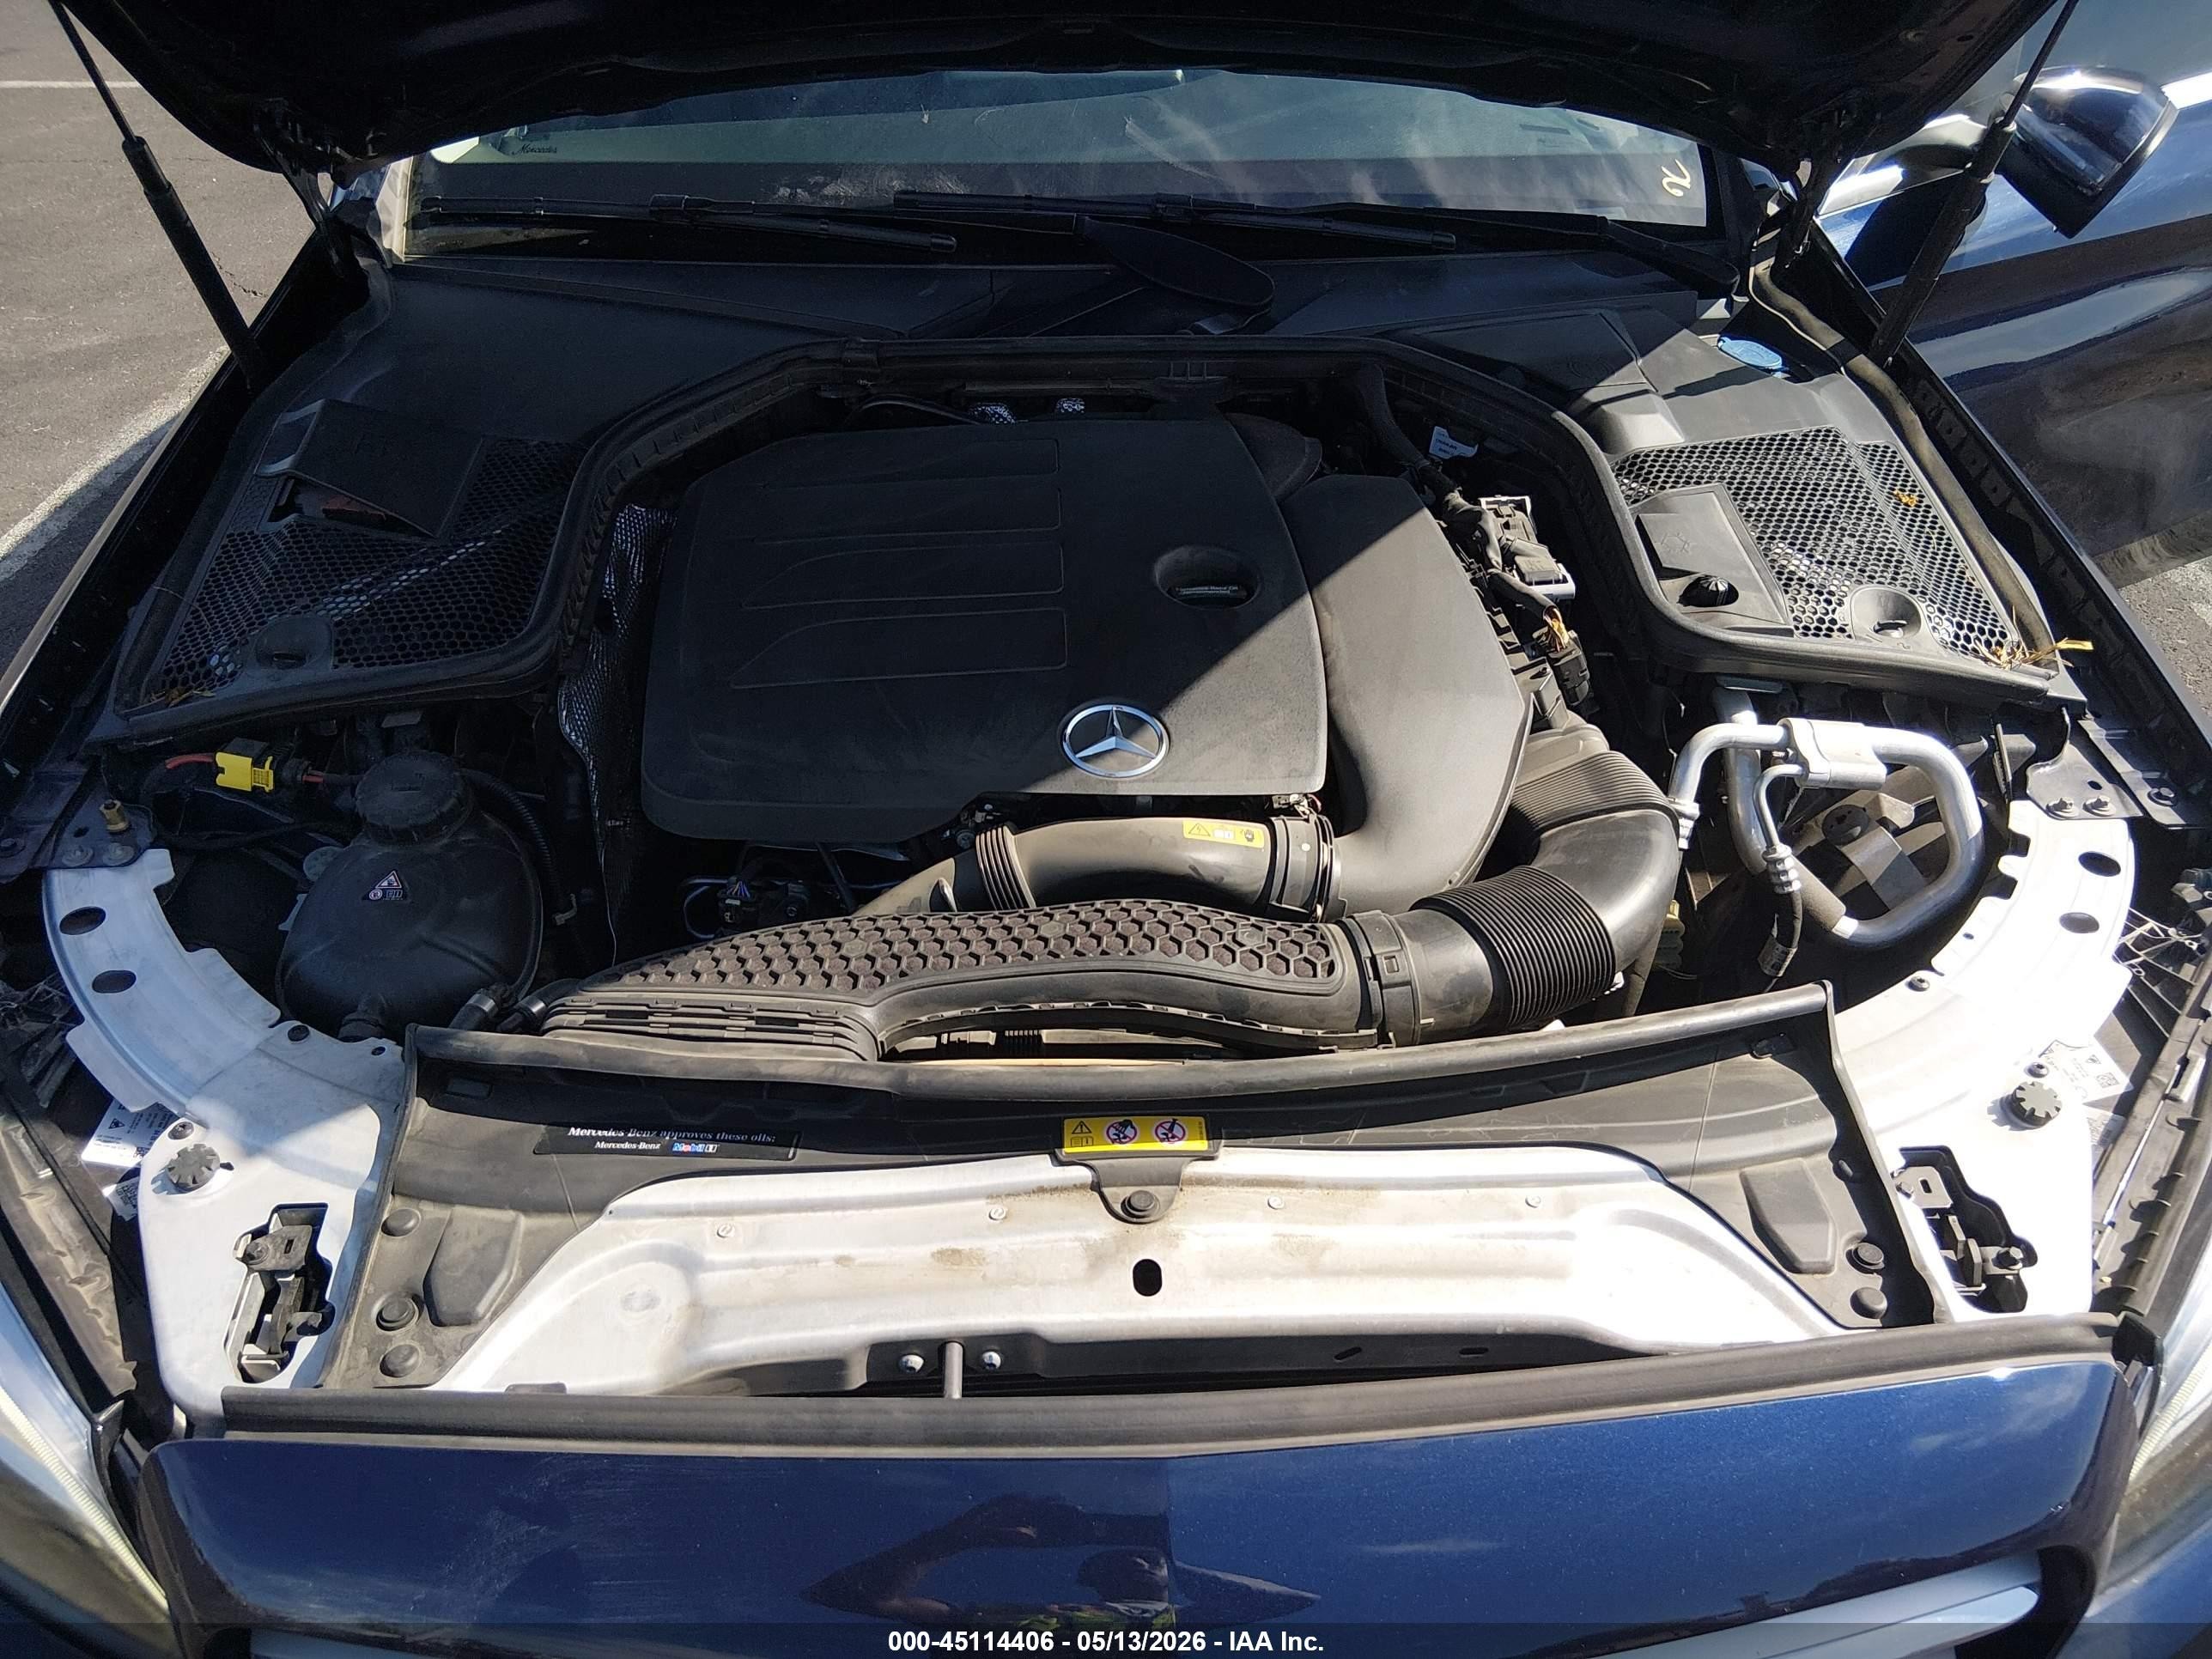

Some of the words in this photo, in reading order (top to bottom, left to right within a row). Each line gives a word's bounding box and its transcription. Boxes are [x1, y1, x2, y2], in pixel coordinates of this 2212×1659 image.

[568, 1127, 658, 1138] Mercedes-Benz
[659, 1130, 713, 1140] approves
[715, 1131, 748, 1140] these
[750, 1133, 776, 1143] oils:
[594, 1141, 661, 1150] Mercedes-Benz
[672, 1142, 705, 1152] Mobil
